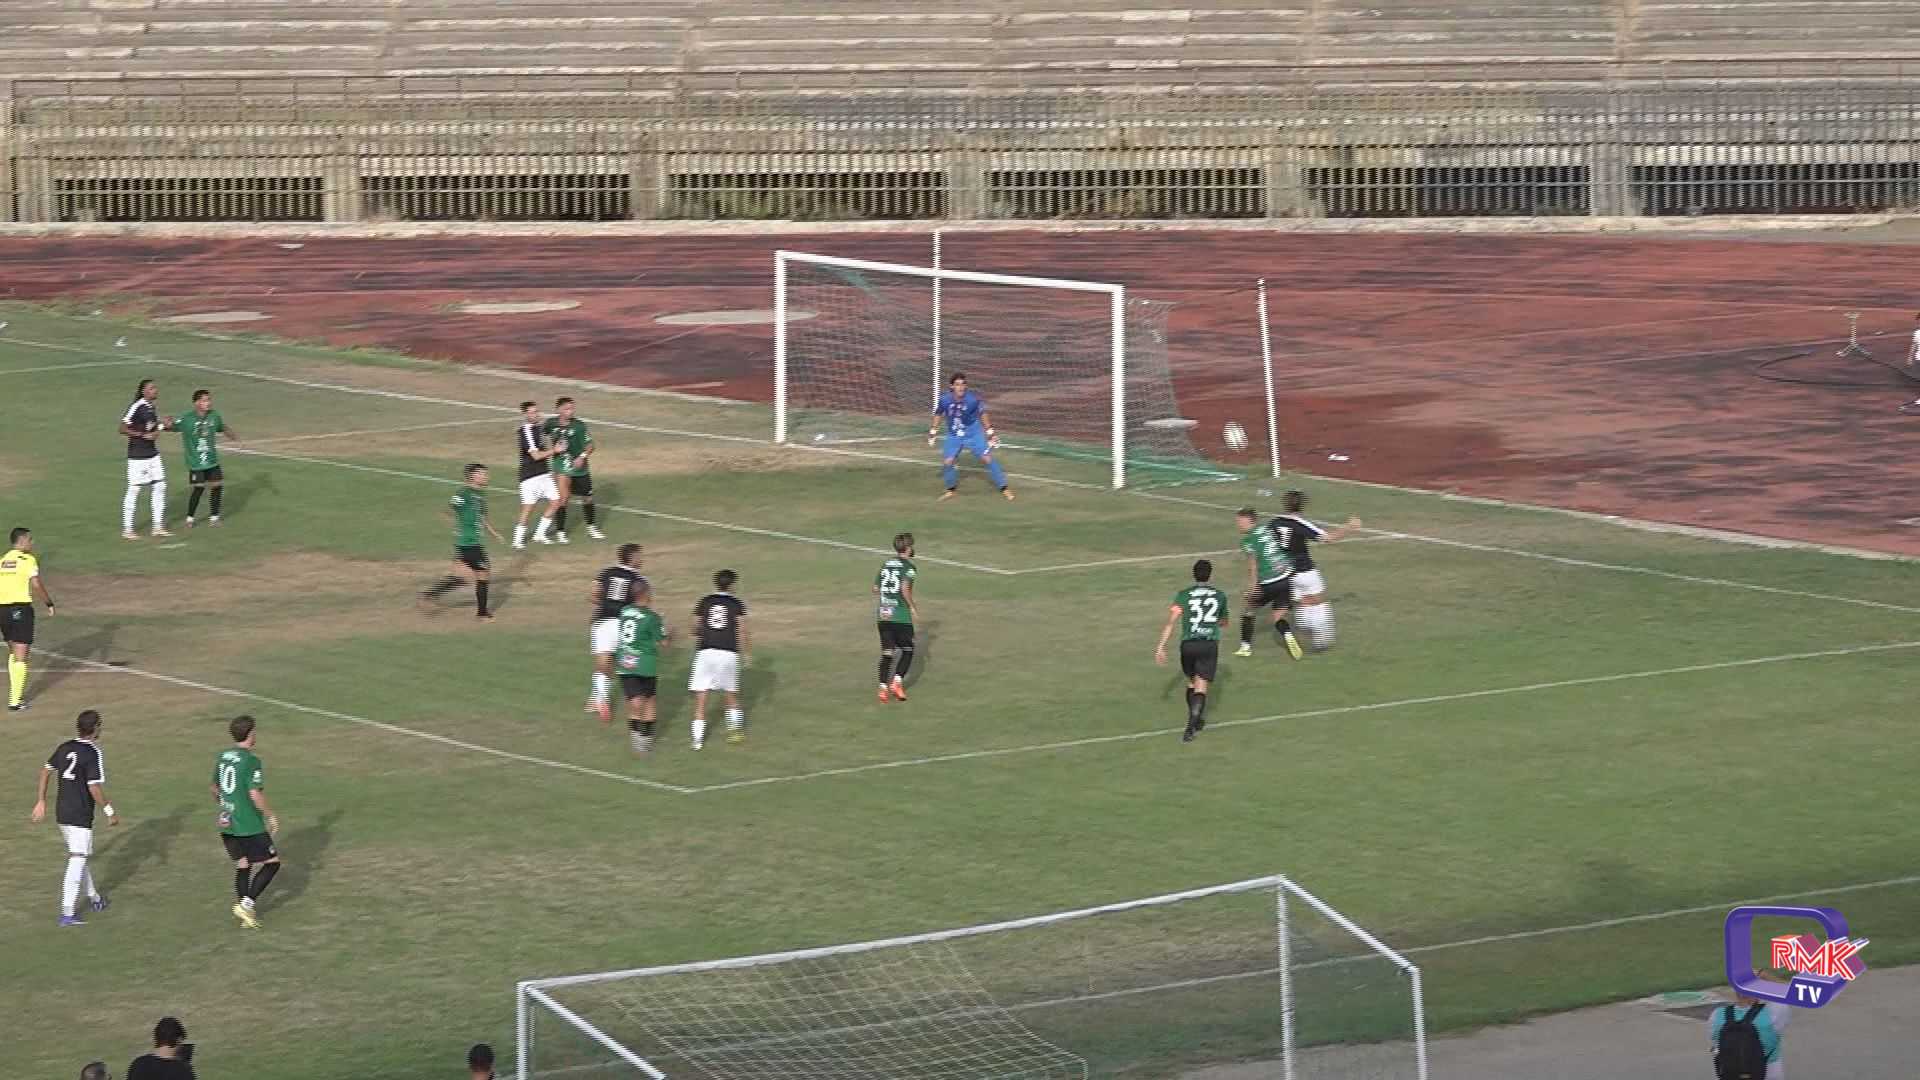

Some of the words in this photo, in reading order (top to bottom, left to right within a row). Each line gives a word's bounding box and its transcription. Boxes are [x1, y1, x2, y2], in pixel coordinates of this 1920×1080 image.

[1276, 526, 1293, 548] 7
[880, 568, 900, 594] 25
[707, 604, 728, 629] 8
[1188, 597, 1219, 623] 32
[621, 619, 638, 644] 8
[62, 751, 78, 780] 2
